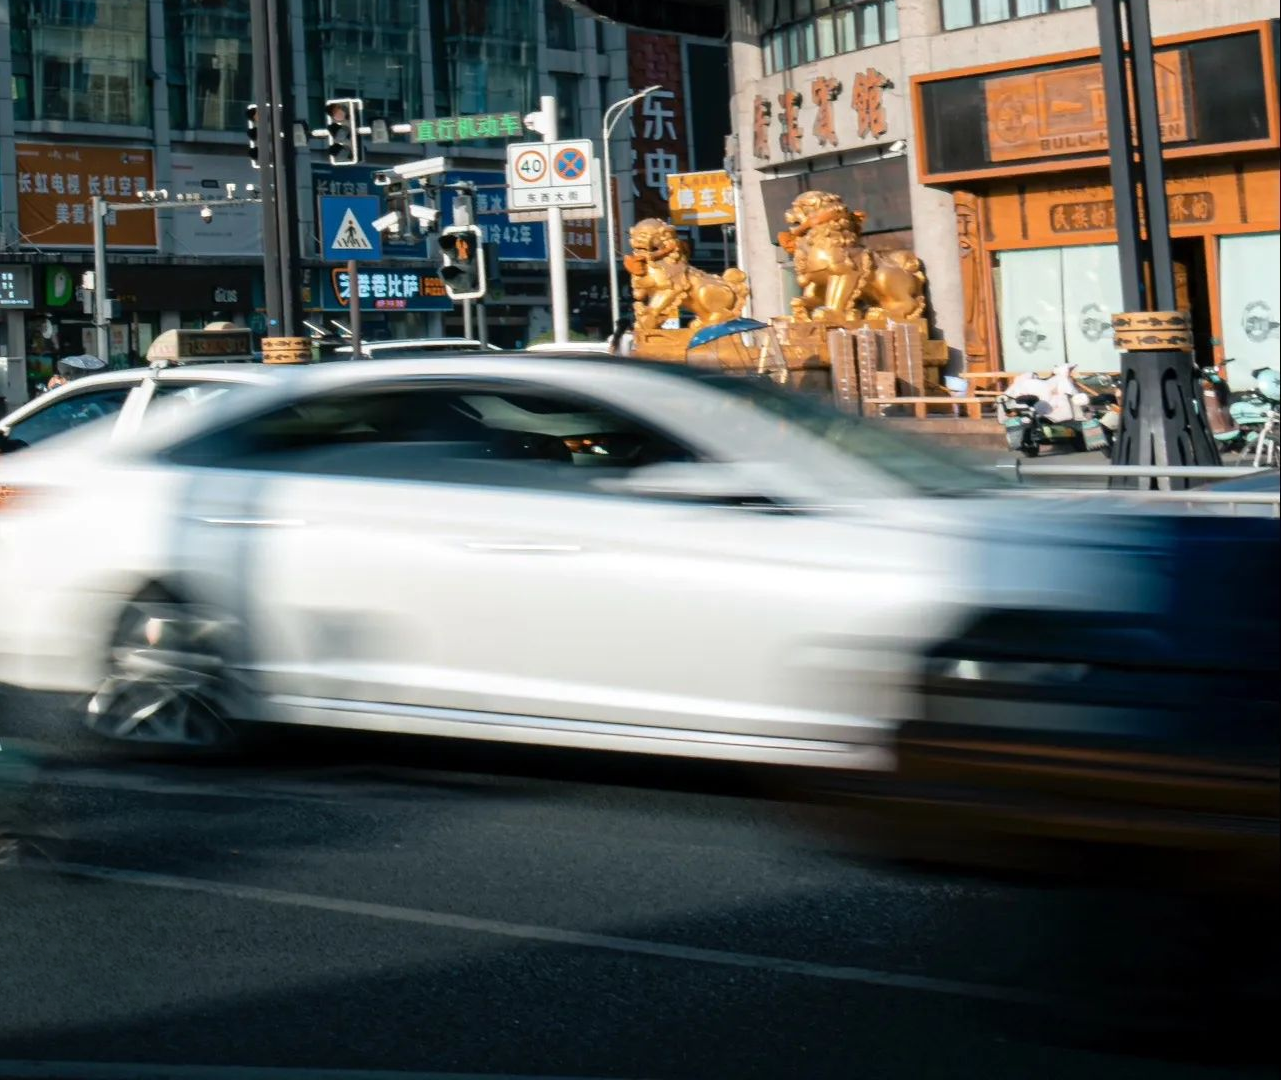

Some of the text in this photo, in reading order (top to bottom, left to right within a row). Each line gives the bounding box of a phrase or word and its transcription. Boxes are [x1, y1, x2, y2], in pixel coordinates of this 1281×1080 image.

[416, 114, 522, 142] 直行机动车
[1040, 133, 1090, 151] BULL
[520, 159, 541, 174] 40
[527, 191, 579, 203] 东西大街
